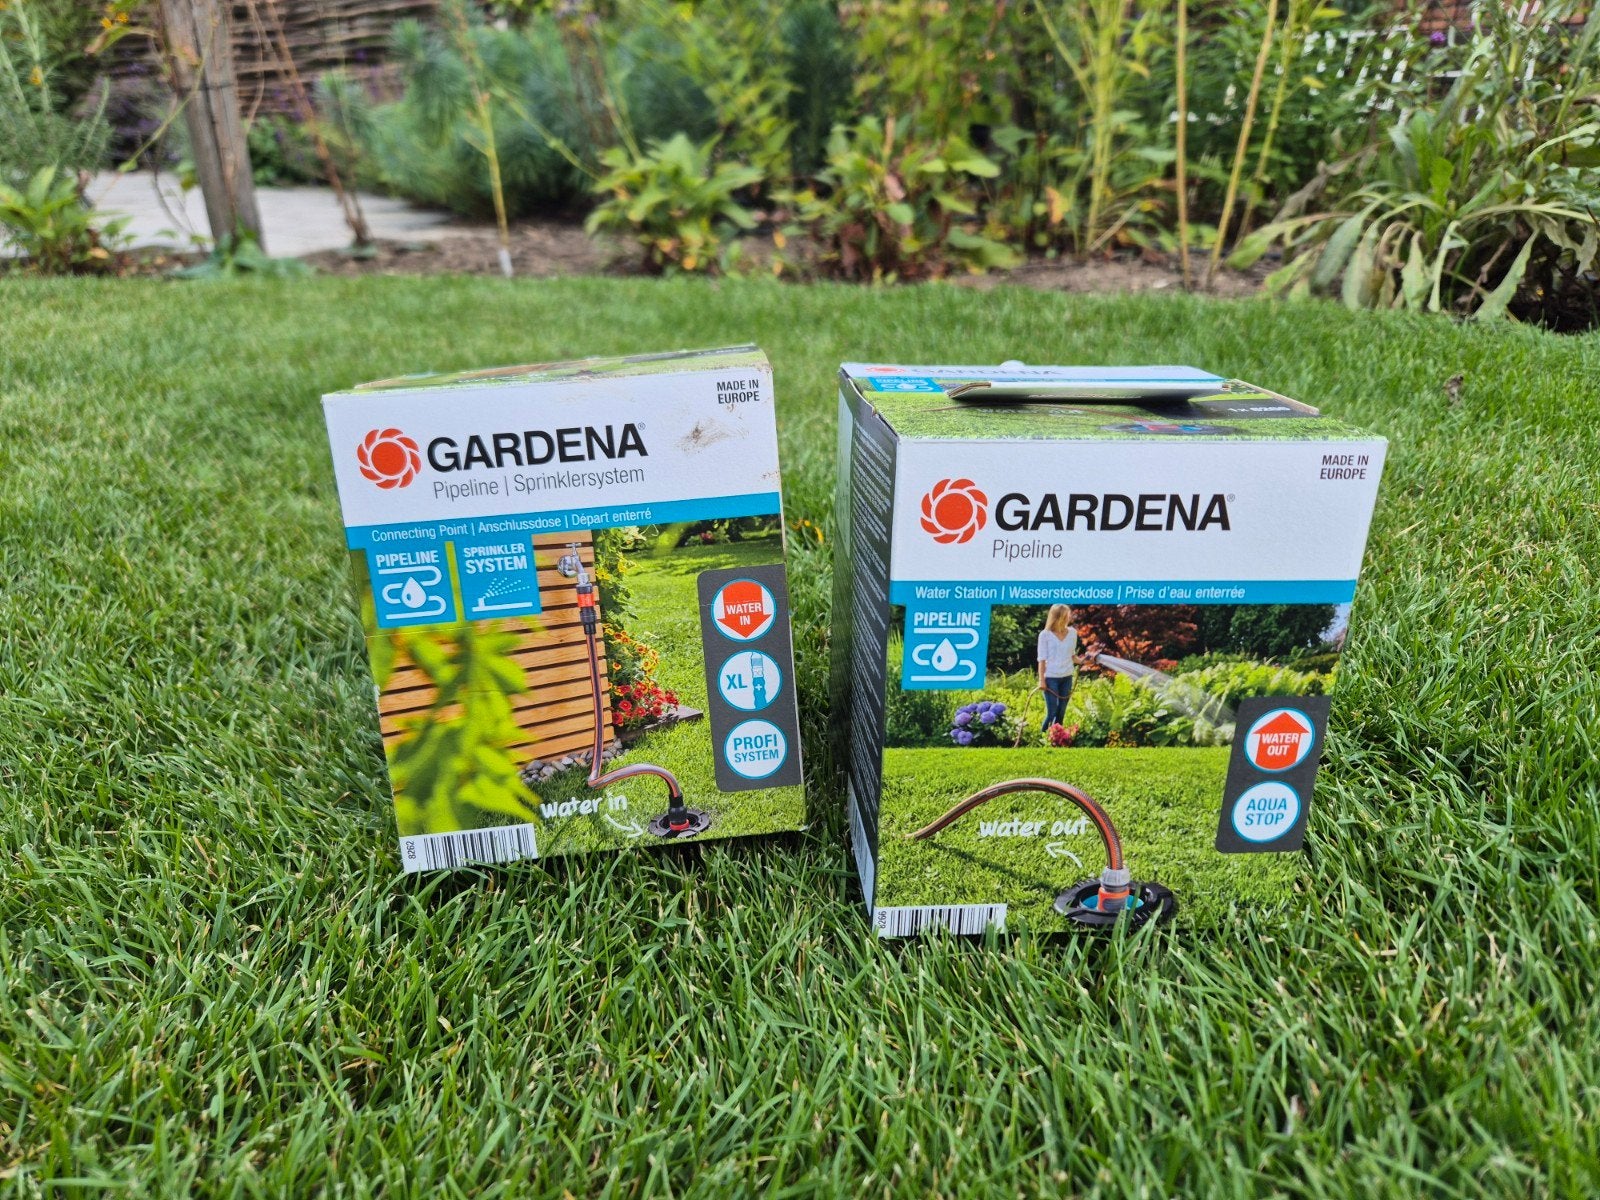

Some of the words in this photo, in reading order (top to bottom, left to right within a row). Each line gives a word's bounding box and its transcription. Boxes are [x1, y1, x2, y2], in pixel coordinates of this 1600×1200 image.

[716, 380, 746, 391] MADE
[749, 379, 759, 389] IN
[717, 391, 760, 404] EUROPE
[1322, 454, 1355, 466] MADE
[1357, 454, 1369, 466] IN
[1320, 467, 1367, 480] EUROPE
[433, 477, 499, 502] Pipeline
[514, 466, 645, 495] Sprinklersystem
[371, 526, 437, 542] Connecting
[439, 523, 469, 537] Point
[478, 516, 562, 534] Anschlussdose
[572, 511, 609, 527] Départ
[613, 507, 652, 523] enterré
[463, 543, 526, 558] SPRINKLER
[992, 539, 1063, 562] Pipeline
[375, 550, 440, 568] PIPELINE
[465, 555, 528, 574] SYSTEM
[915, 585, 950, 599] Water
[954, 585, 998, 599] Station
[1009, 585, 1114, 599] Wassersteckdose
[1125, 585, 1155, 599] Prise
[1195, 585, 1246, 599] enterrée
[726, 602, 762, 615] WATER
[739, 614, 751, 626] IN
[914, 611, 982, 627] PIPELINE
[726, 673, 748, 690] XL
[733, 733, 778, 751] PROFI
[1261, 732, 1300, 744] WATER
[734, 749, 779, 763] SYSTEM
[1267, 744, 1290, 756] OUT
[540, 796, 603, 819] water
[606, 789, 628, 811] in
[1246, 798, 1288, 812] AQUA
[1244, 812, 1285, 826] STOP
[979, 817, 1046, 837] water
[1051, 816, 1091, 836] out
[405, 840, 417, 860] 8262
